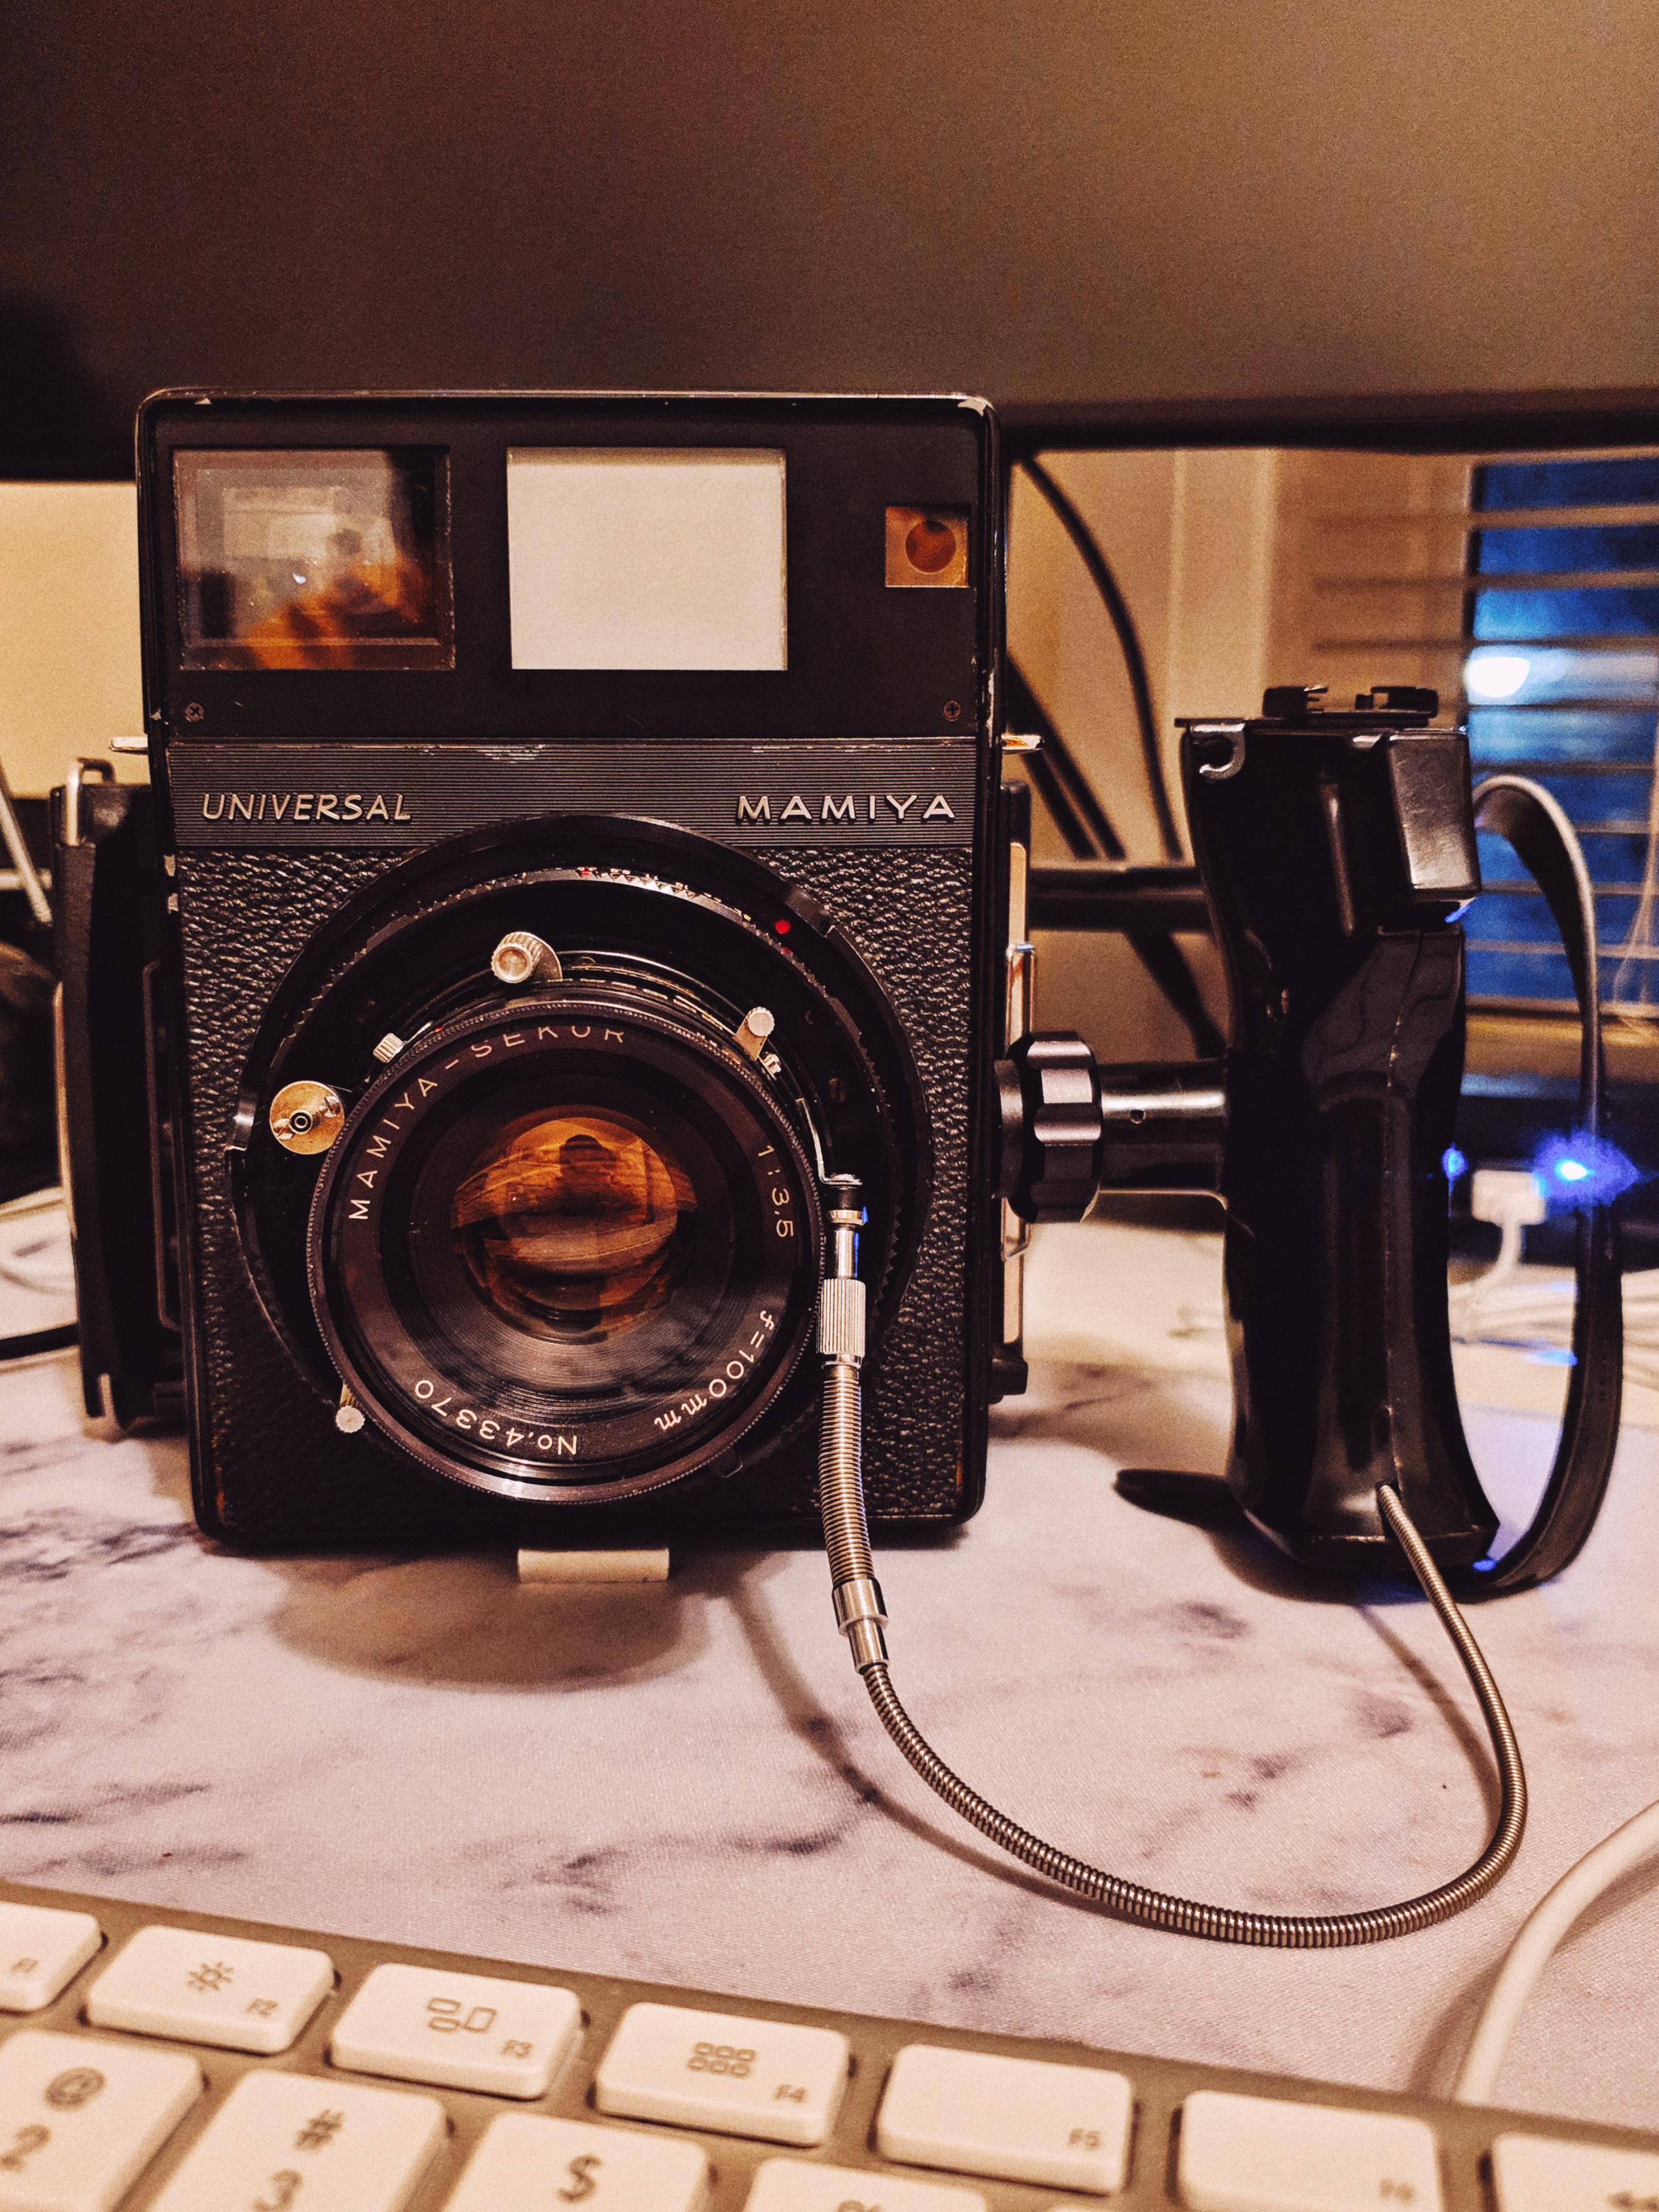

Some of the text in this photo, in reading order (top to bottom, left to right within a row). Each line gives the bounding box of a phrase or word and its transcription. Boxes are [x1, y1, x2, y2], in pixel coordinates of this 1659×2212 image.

[201, 793, 413, 822] UNIVERSAL
[737, 794, 957, 821] MAMIYA
[502, 2040, 533, 2059] F3
[43, 2067, 106, 2111] @
[775, 2084, 807, 2103] F4
[294, 2109, 346, 2152] #
[1068, 2128, 1102, 2149] F5
[0, 2124, 51, 2171] 2
[253, 2169, 305, 2212] 3
